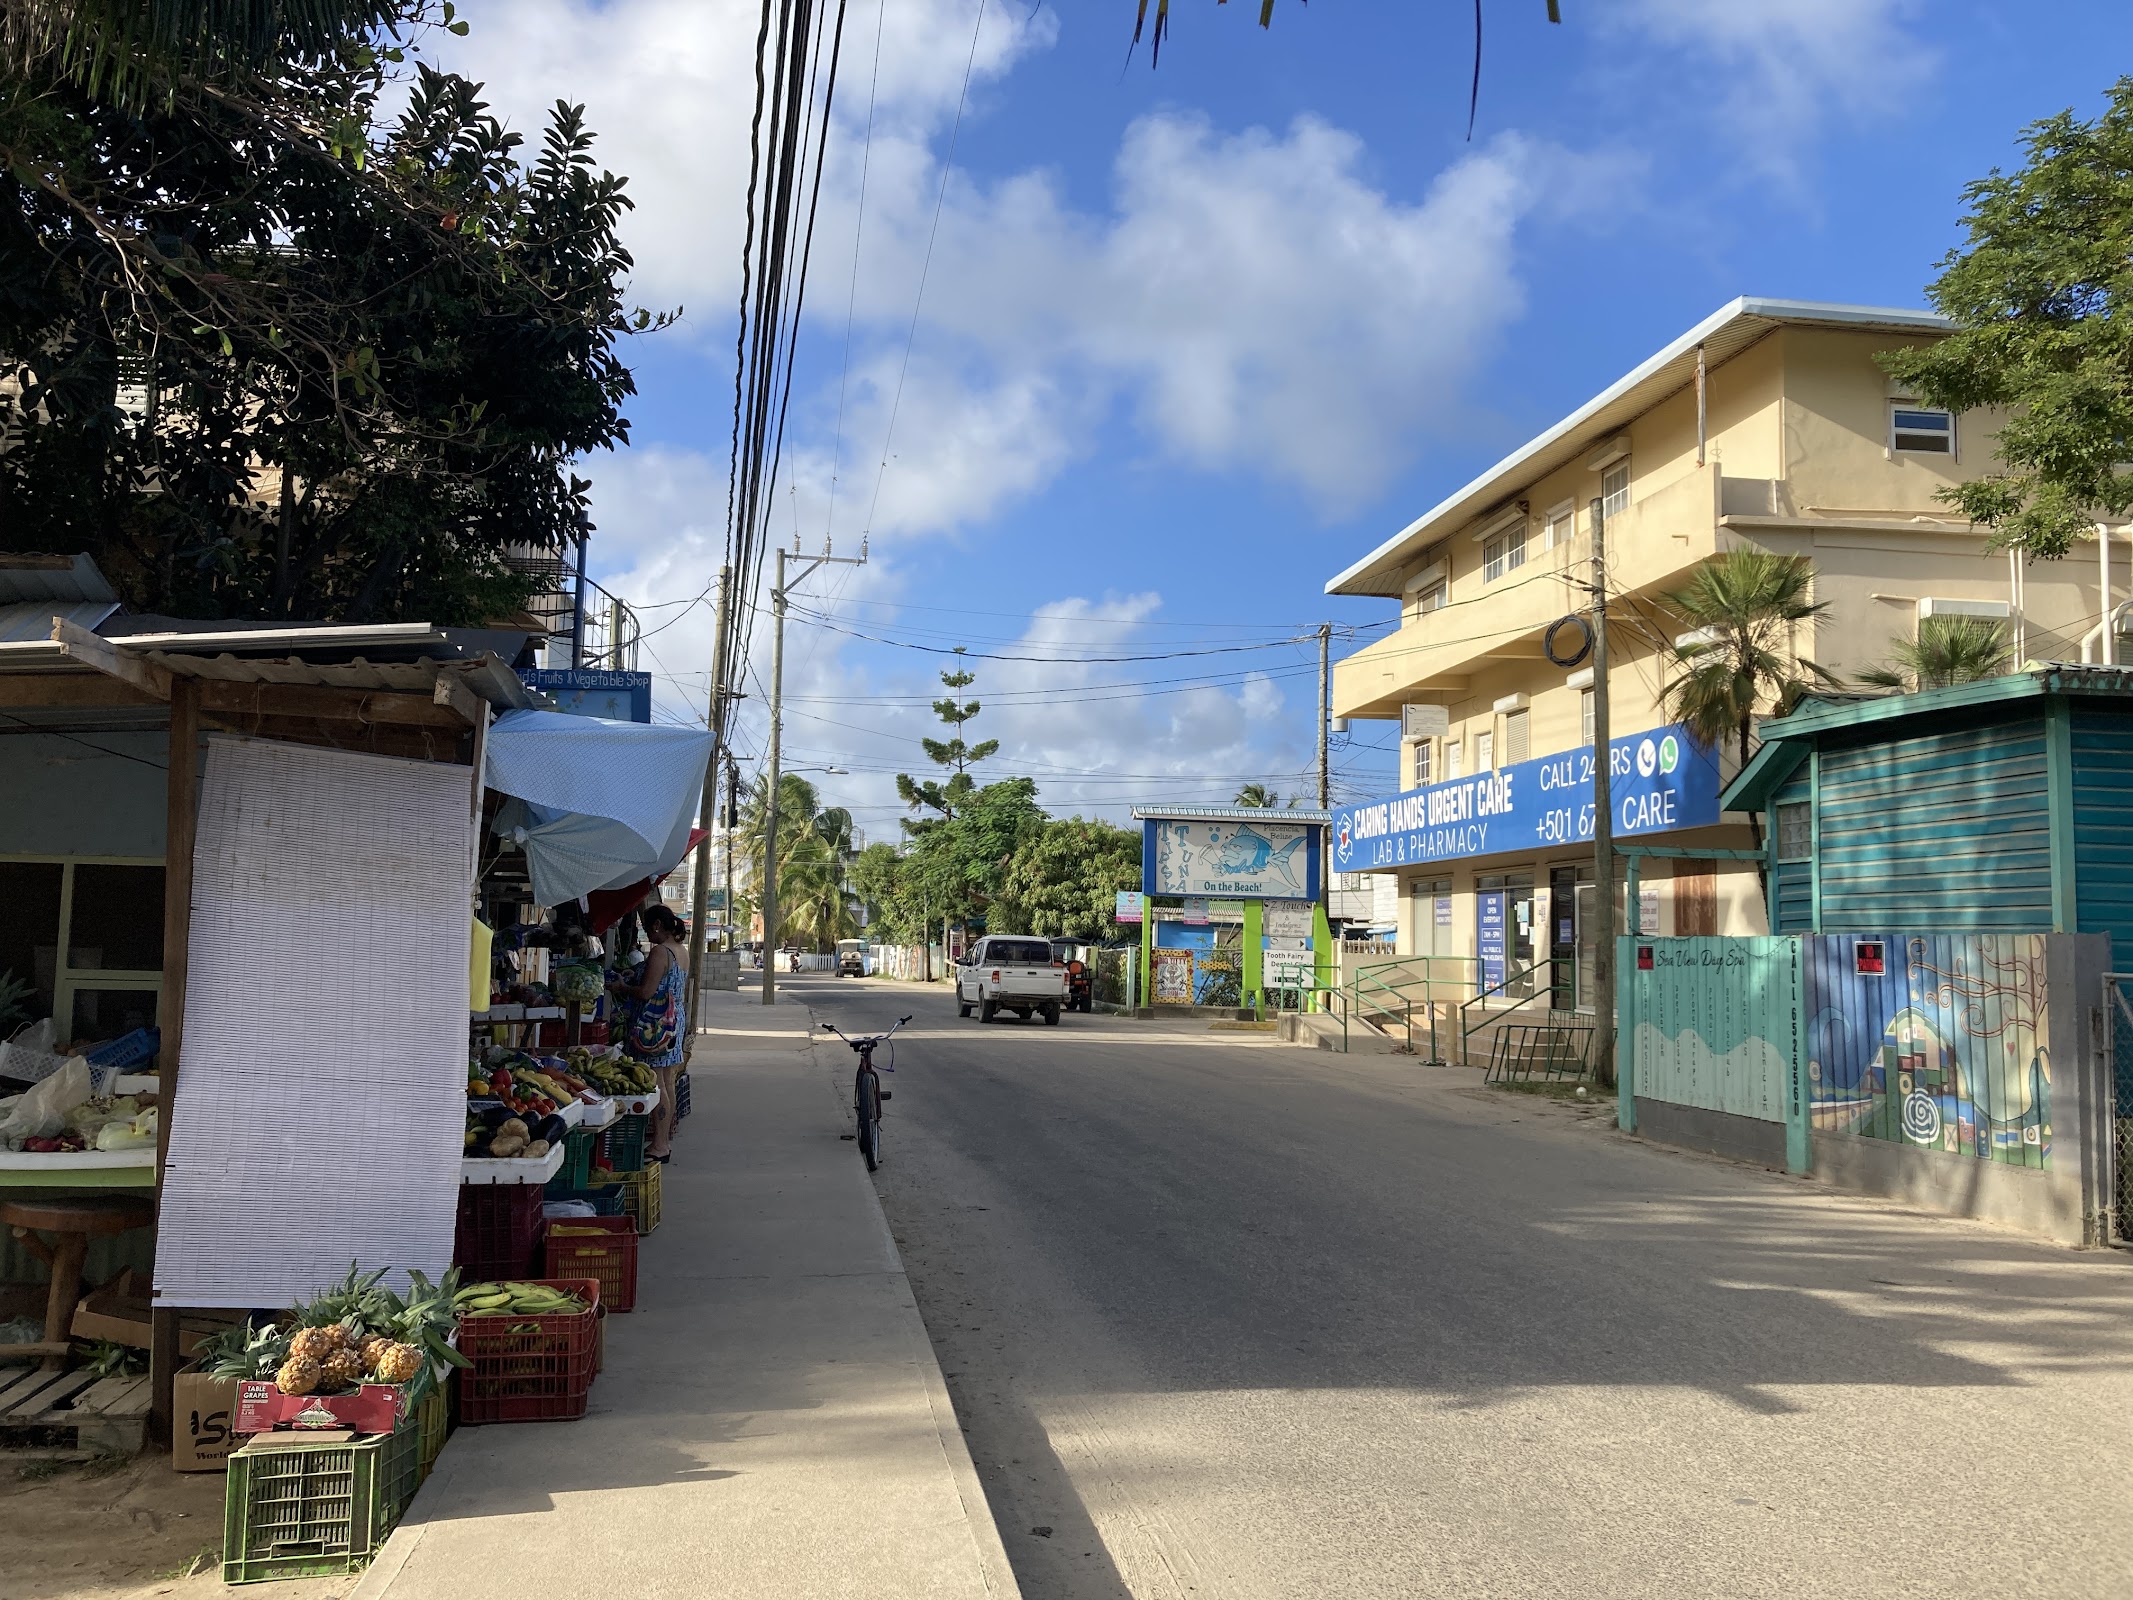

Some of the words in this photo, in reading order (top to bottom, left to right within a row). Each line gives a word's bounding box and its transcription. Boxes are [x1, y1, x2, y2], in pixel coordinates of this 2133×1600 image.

[538, 670, 563, 685] Fruits
[567, 670, 573, 685] &
[573, 671, 624, 689] Vegetable
[626, 673, 649, 689] Shop
[1540, 761, 1577, 791] CALL
[1610, 745, 1631, 777] RS
[1354, 803, 1388, 840] CARING
[1390, 795, 1425, 834] HANDS
[1428, 783, 1474, 827] URGENT
[1477, 773, 1513, 817] CARE
[1535, 807, 1572, 842] +501
[1622, 789, 1676, 830] CARE
[1174, 825, 1194, 893] TUNA
[1373, 839, 1393, 865] LAB
[1397, 837, 1405, 862] &
[1410, 822, 1488, 860] PHARMACY
[1204, 881, 1217, 891] On
[1218, 881, 1233, 891] the
[1234, 882, 1262, 892] Beach!
[1287, 952, 1304, 961] Fairy
[1657, 950, 1674, 967] Sea
[1675, 950, 1698, 967] View
[1701, 949, 1724, 975] Day
[1725, 948, 1745, 975] Spa
